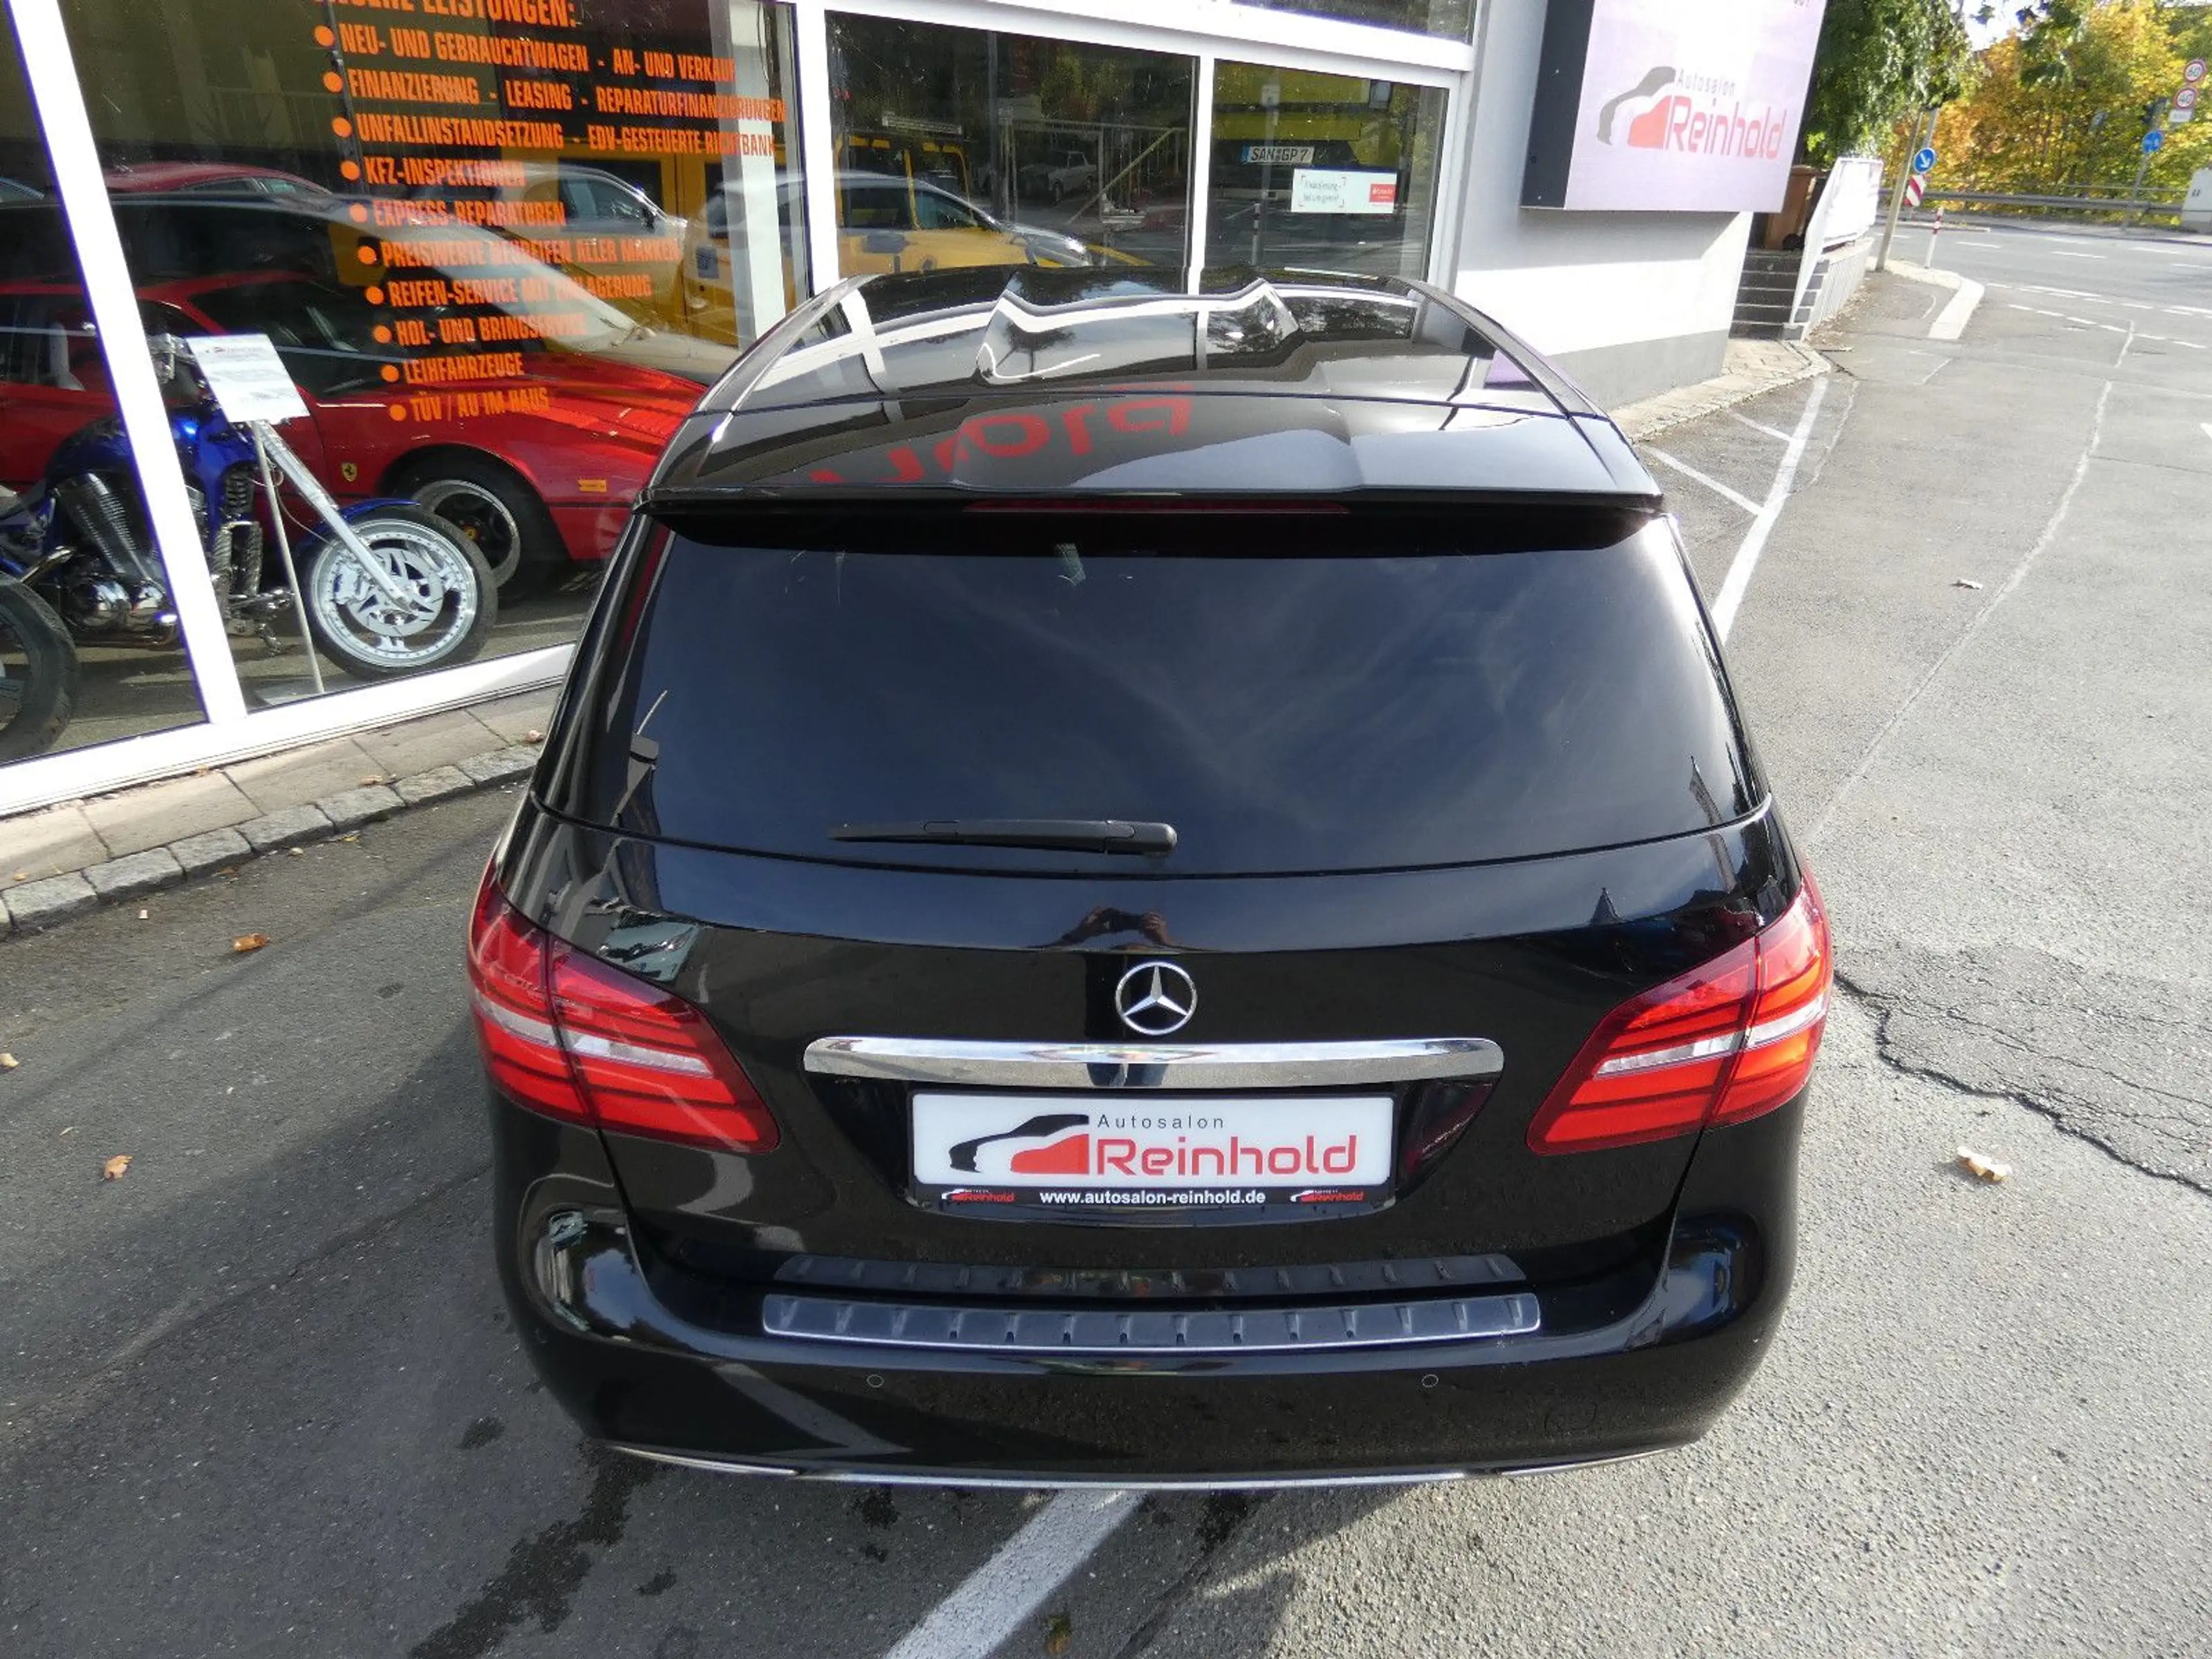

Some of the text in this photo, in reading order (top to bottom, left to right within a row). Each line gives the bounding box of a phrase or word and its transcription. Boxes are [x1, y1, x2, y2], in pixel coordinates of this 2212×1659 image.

[339, 23, 386, 55] NEU-
[389, 27, 430, 58] UND
[435, 32, 589, 71] GEBRAUCHTWAGEN
[613, 48, 641, 74] AN-
[644, 51, 675, 78] UND
[677, 55, 736, 82] VERKAUF
[347, 69, 480, 104] FINANZIERUNG
[505, 79, 572, 111] LEASING
[356, 113, 564, 149] UNFALLINSTANDSETZUNG
[588, 124, 701, 154] EDV-GESTEUERTE
[1666, 96, 1787, 160] Reinhold
[364, 156, 525, 187] KFZ-INSPEKTIONEN
[389, 278, 518, 307] REIFEN-SERVICE
[396, 320, 436, 345] HOL-
[439, 318, 475, 343] UND
[404, 353, 524, 384] LEIHFAHRZEUGE
[410, 391, 442, 422] TÜV
[457, 393, 479, 417] AU
[1098, 1114, 1225, 1130] Autosalon
[1097, 1135, 1357, 1176] Reinhold
[1039, 1190, 1265, 1205] www.autosalon-reinhold.de
